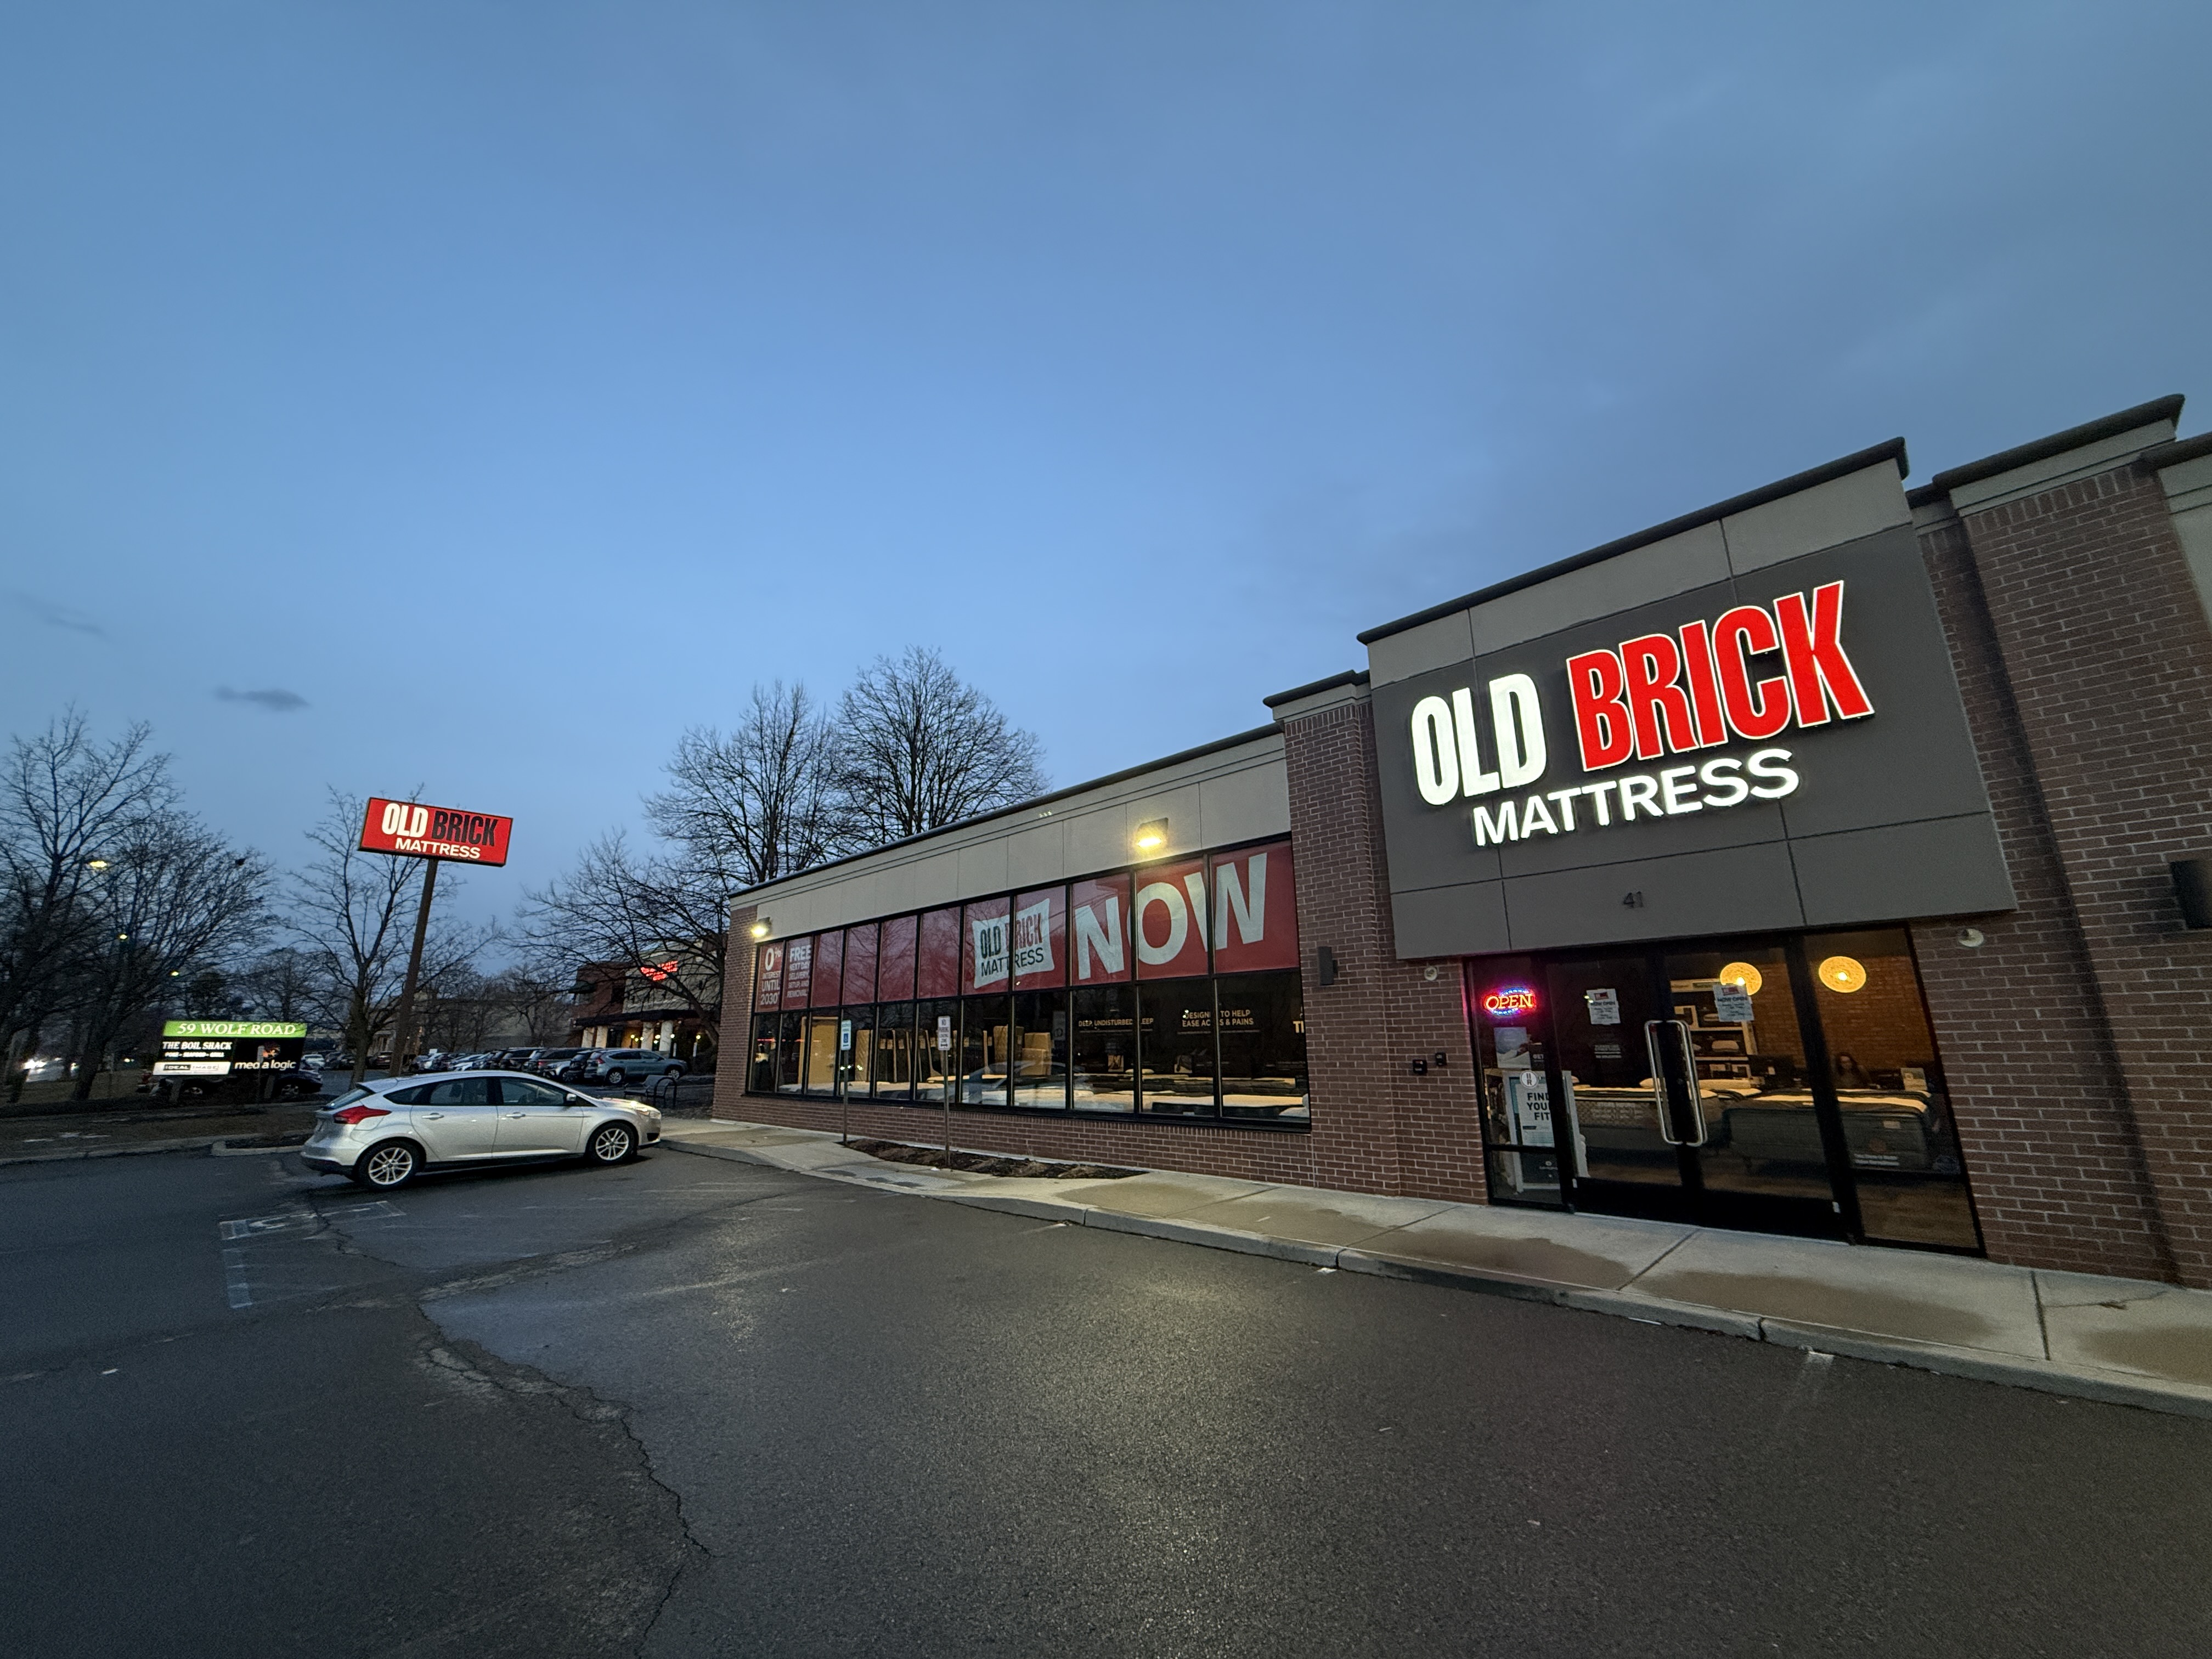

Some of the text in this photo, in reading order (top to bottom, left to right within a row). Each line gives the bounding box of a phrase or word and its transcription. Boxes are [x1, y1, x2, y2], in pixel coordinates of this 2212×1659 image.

[1410, 579, 1875, 807] OLD BRICK
[1472, 747, 1801, 848] MATTRESS
[382, 803, 499, 847] OLD BRICK
[395, 837, 481, 859] MATTRESS
[1075, 852, 1268, 980] NOW
[980, 912, 1043, 960] OLD BRICK
[765, 946, 782, 972] 0%
[789, 945, 811, 963] FREE
[981, 947, 1045, 977] MATTRESS
[763, 970, 781, 980] INTEREST
[789, 963, 800, 971] NEXT
[761, 979, 780, 992] UNTIL
[1485, 993, 1534, 1011] OPEN
[1182, 1019, 1200, 1028] EASE
[1201, 1018, 1224, 1026] ACS
[1232, 1017, 1255, 1026] PAINS
[1183, 1011, 1211, 1019] DESIGN
[1232, 1009, 1251, 1017] HELP
[177, 1023, 296, 1035] 59 WOLF ROAD
[162, 1041, 233, 1051] THE BOIL SHACK
[1526, 1102, 1548, 1111] YOU
[1534, 1112, 1550, 1121] FIT
